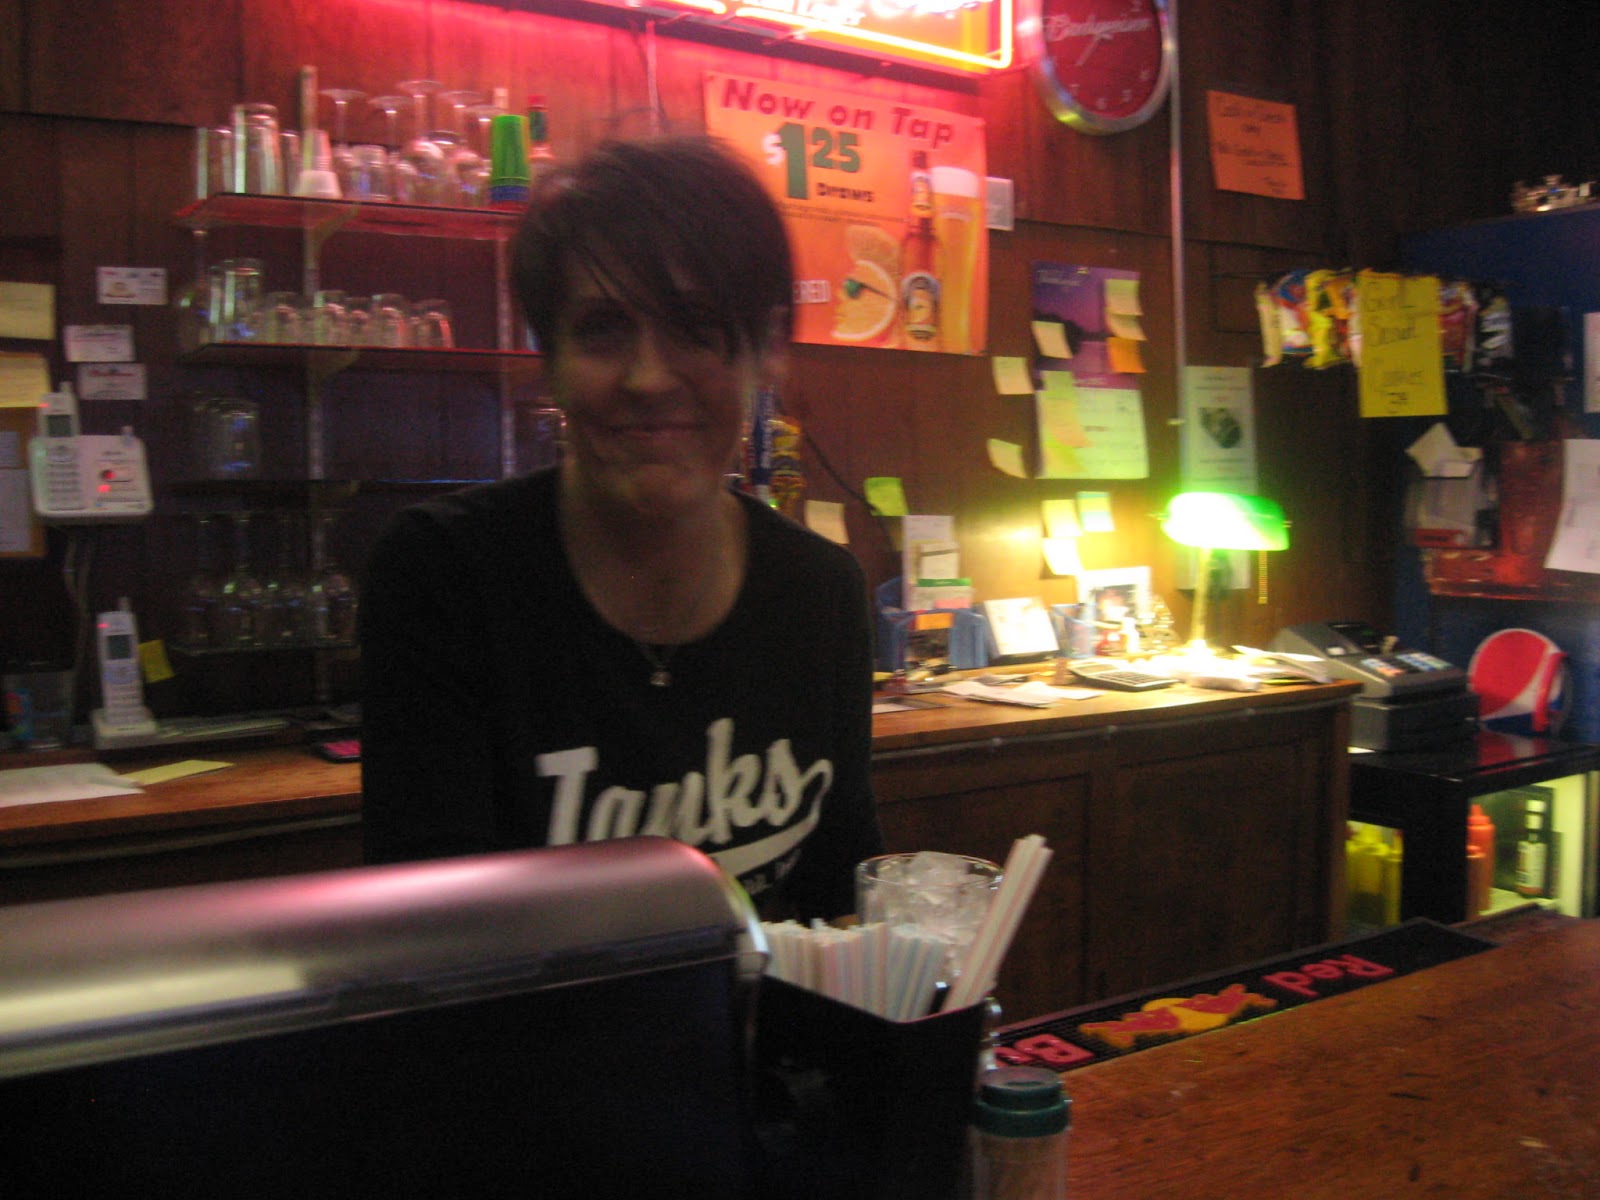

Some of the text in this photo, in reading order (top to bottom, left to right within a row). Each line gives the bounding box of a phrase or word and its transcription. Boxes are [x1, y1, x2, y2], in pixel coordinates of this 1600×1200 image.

[720, 79, 954, 149] Now on Tap
[1261, 954, 1395, 998] Red
